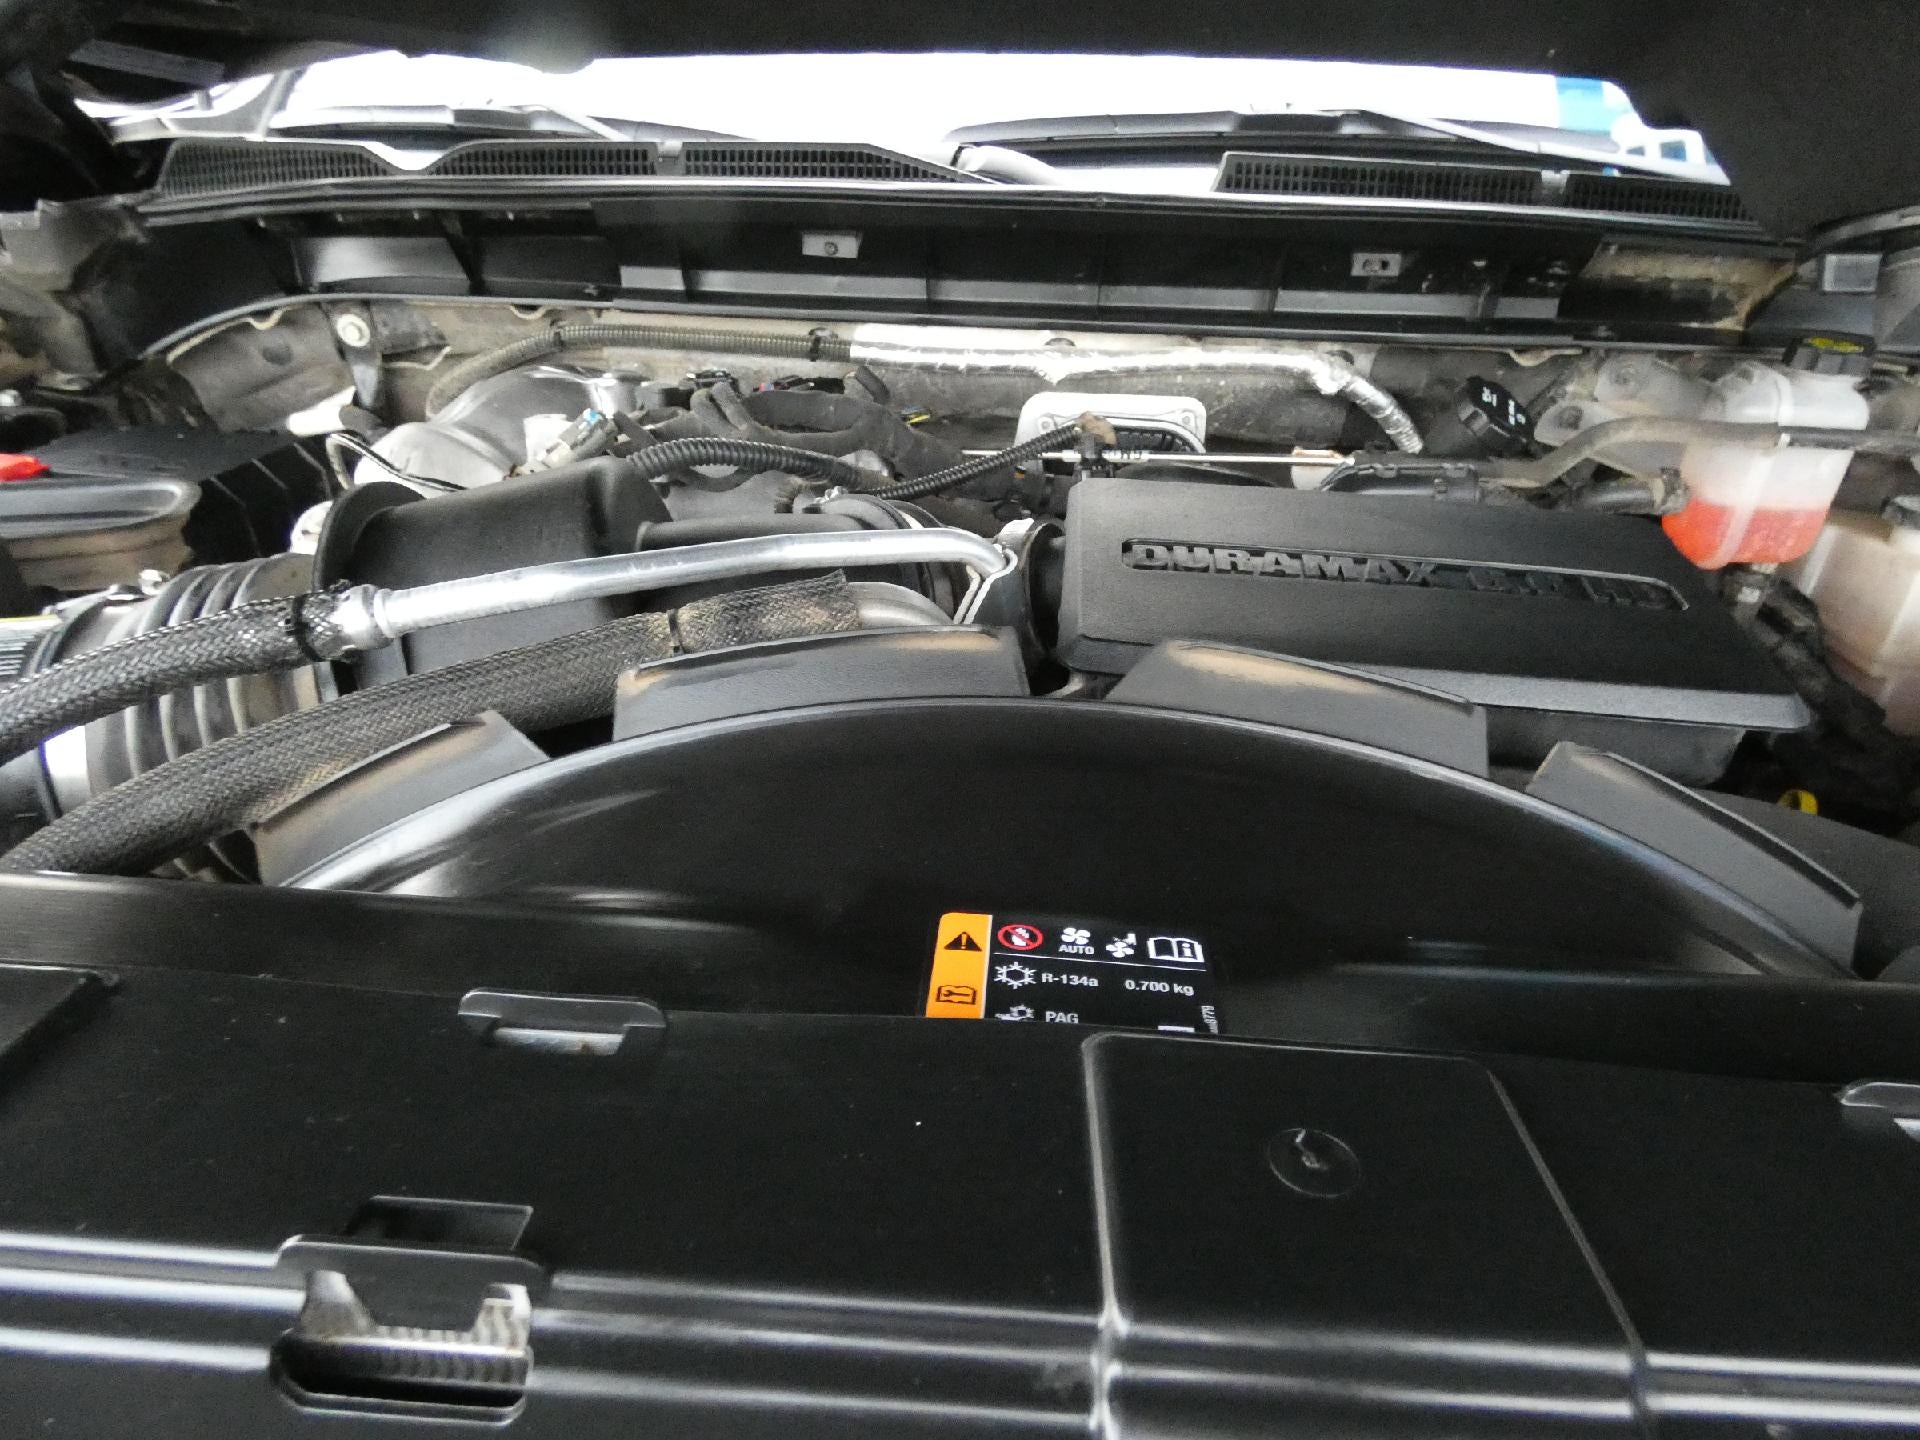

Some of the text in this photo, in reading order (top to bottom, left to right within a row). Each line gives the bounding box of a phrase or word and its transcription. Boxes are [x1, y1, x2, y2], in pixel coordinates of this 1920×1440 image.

[1130, 543, 1437, 586] DURAMAX
[1058, 944, 1095, 955] AUTO
[1041, 972, 1099, 987] R-134a
[1125, 979, 1195, 997] 0.700 kg
[1045, 1010, 1079, 1024] PAG
